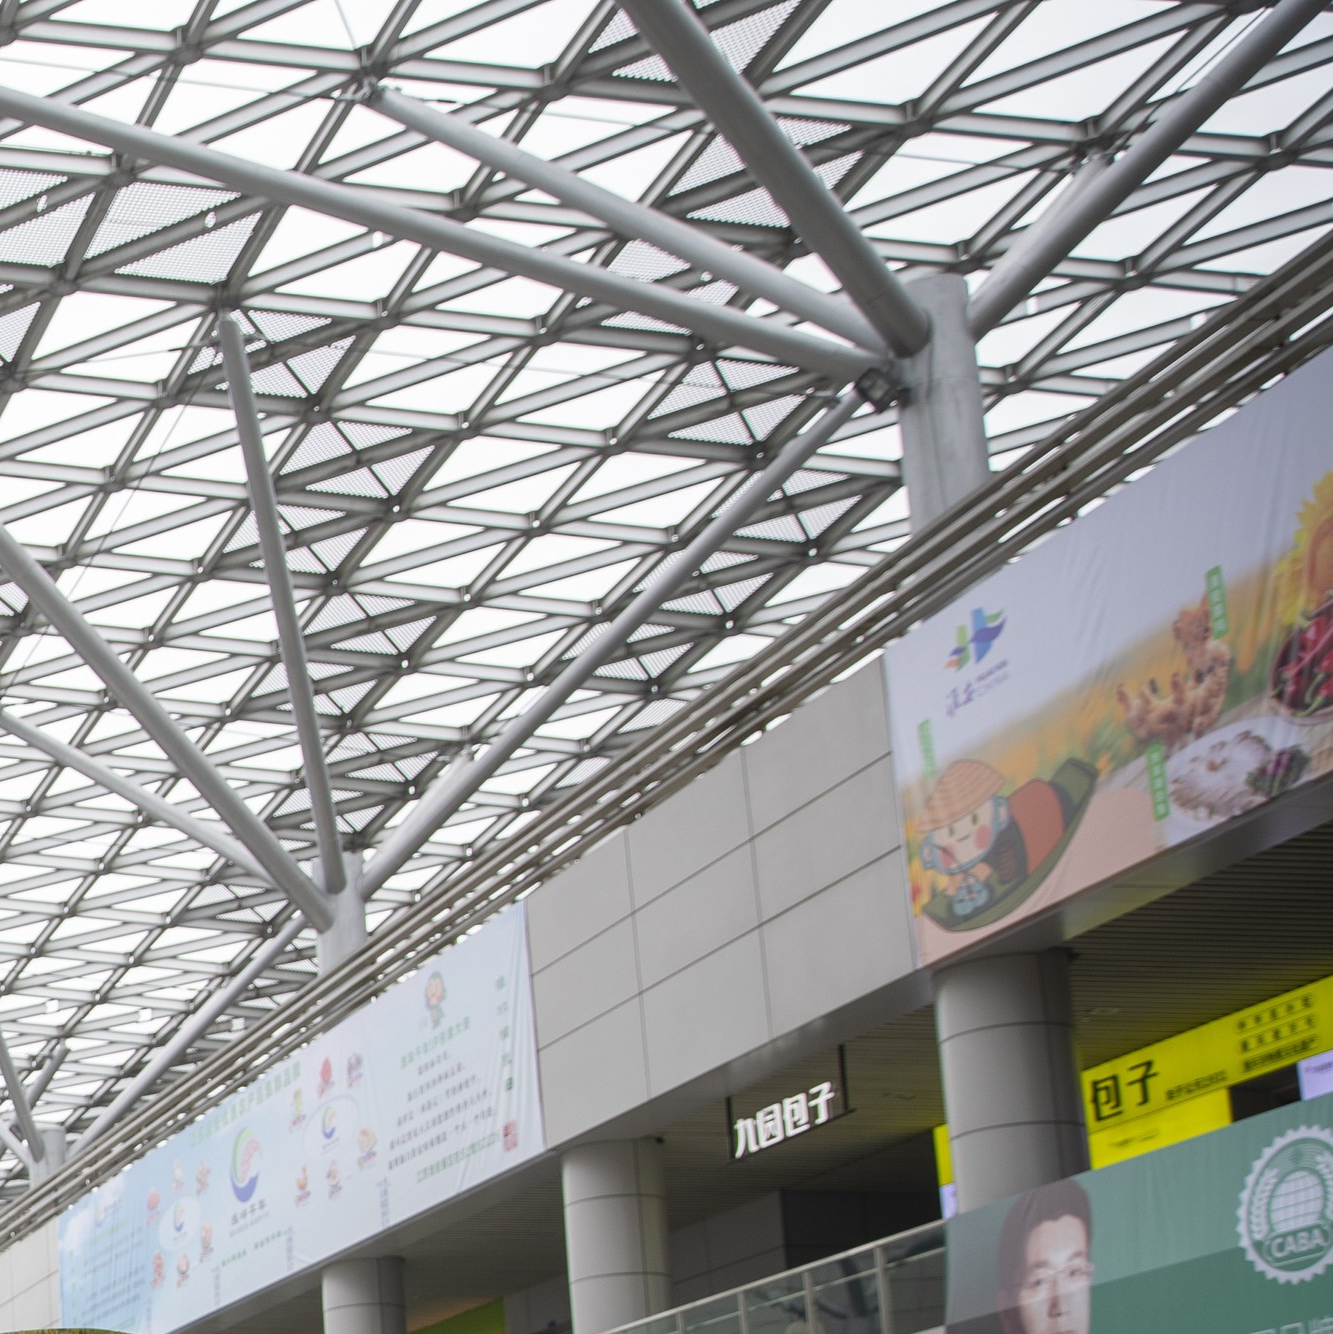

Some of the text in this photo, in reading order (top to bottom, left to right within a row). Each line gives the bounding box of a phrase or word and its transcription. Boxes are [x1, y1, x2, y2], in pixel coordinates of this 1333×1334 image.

[734, 1080, 835, 1160] 九园包子
[1089, 1058, 1161, 1122] 包子
[1270, 1227, 1325, 1260] CABA
